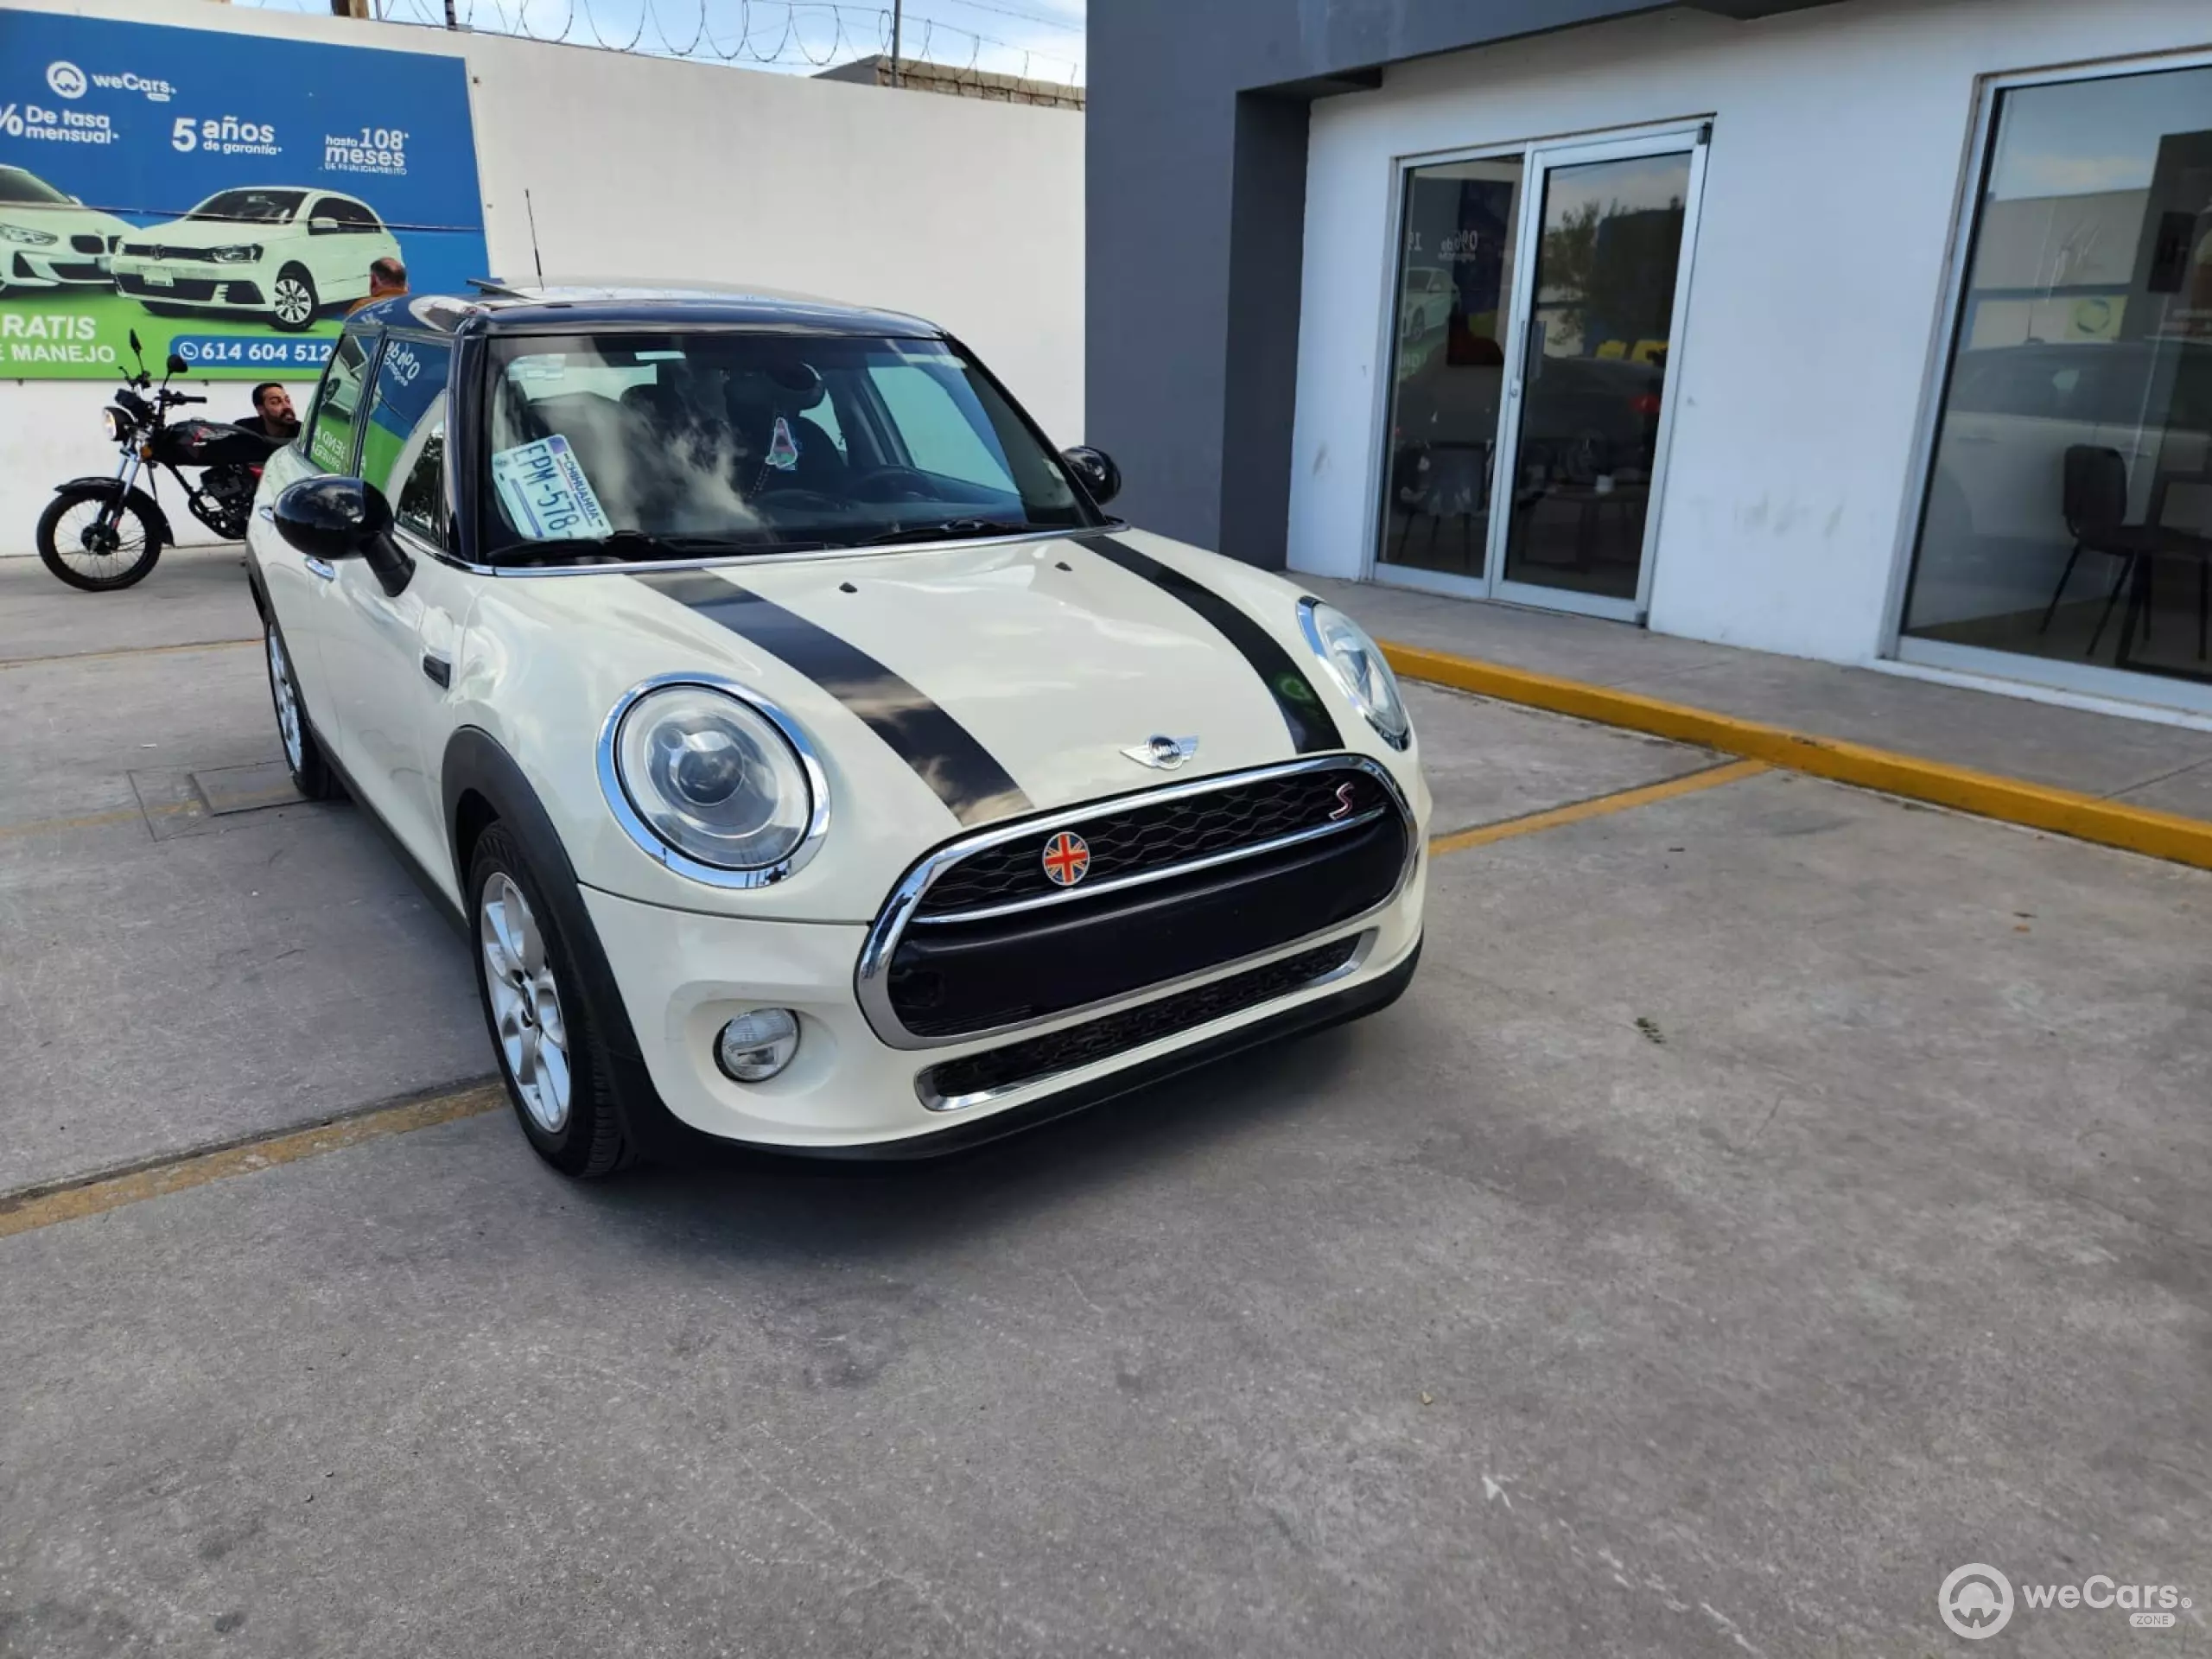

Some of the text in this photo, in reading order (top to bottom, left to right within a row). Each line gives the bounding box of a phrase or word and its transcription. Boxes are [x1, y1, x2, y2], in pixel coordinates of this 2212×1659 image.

[25, 105, 58, 124] De
[62, 108, 111, 129] tasa
[172, 114, 276, 152] 5 años
[324, 133, 359, 147] hasta
[202, 138, 220, 151] de
[325, 146, 405, 167] meses
[10, 343, 117, 363] MANEJO
[201, 342, 242, 360] 614
[248, 344, 288, 361] 604
[563, 461, 600, 520] CHIHUAHUA
